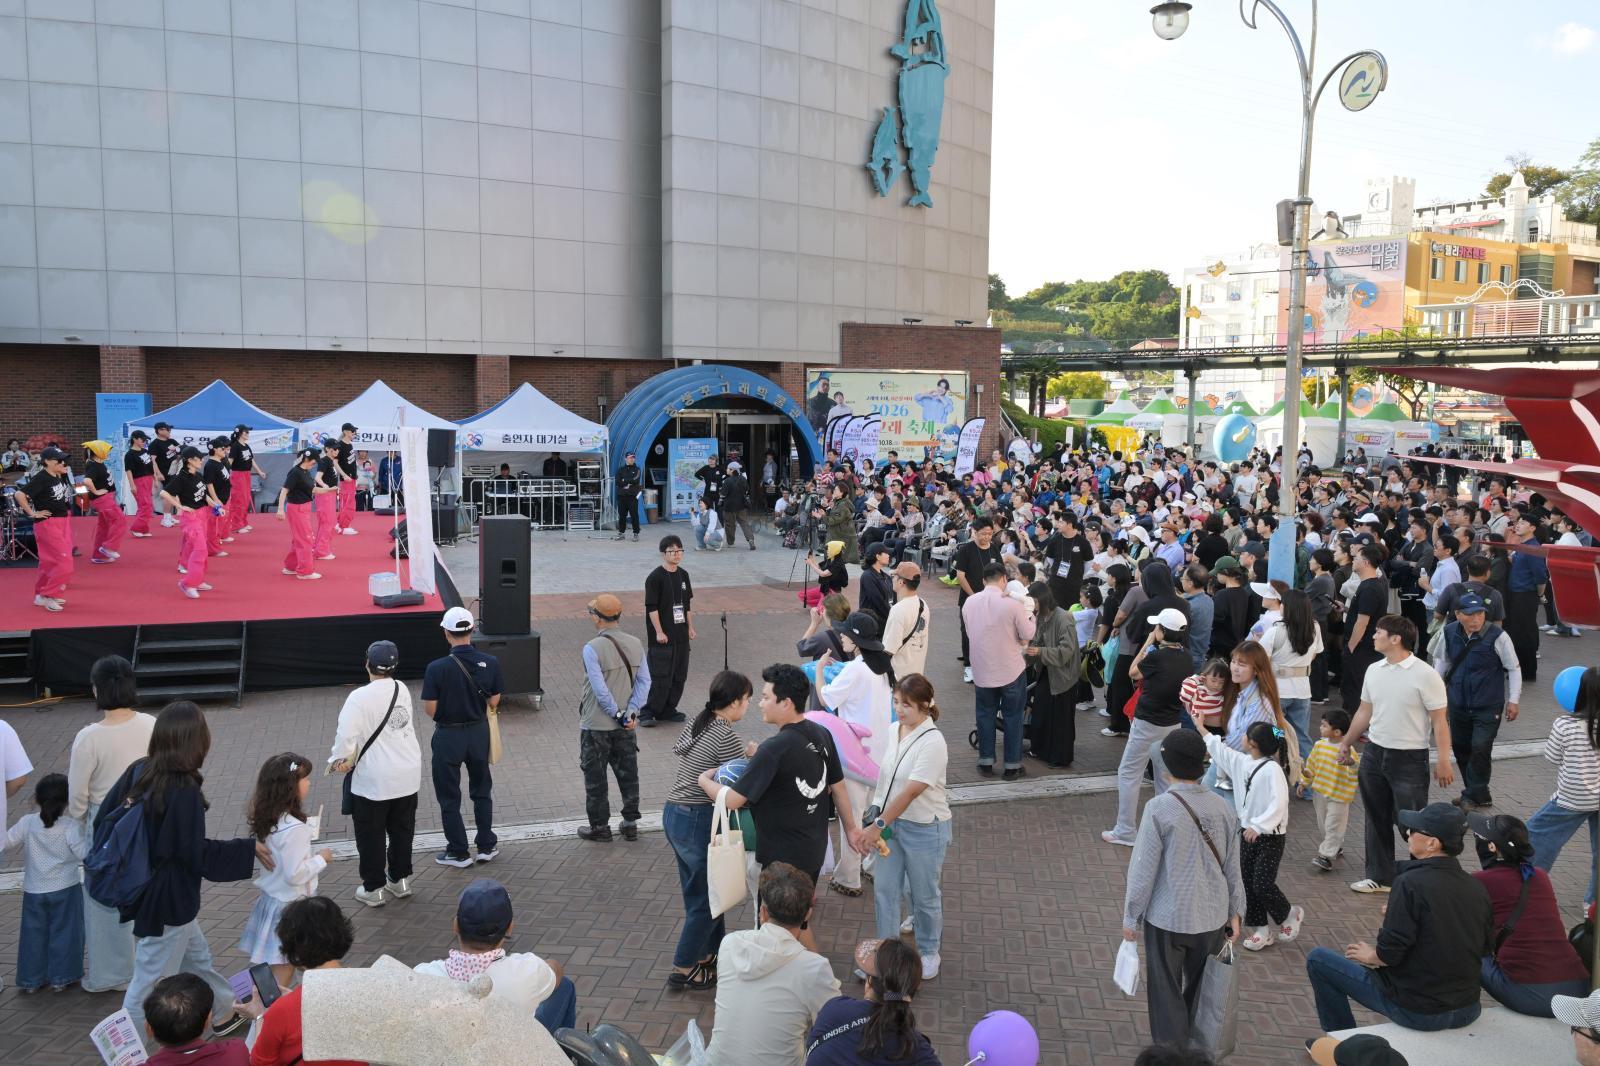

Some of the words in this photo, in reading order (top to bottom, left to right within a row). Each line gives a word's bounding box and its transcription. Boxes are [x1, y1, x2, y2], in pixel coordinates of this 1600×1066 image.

[871, 403, 909, 417] 2026
[906, 418, 935, 436] 축제
[501, 433, 532, 444] 출연자
[536, 434, 567, 445] 대기실
[823, 1024, 850, 1040] UNDER
